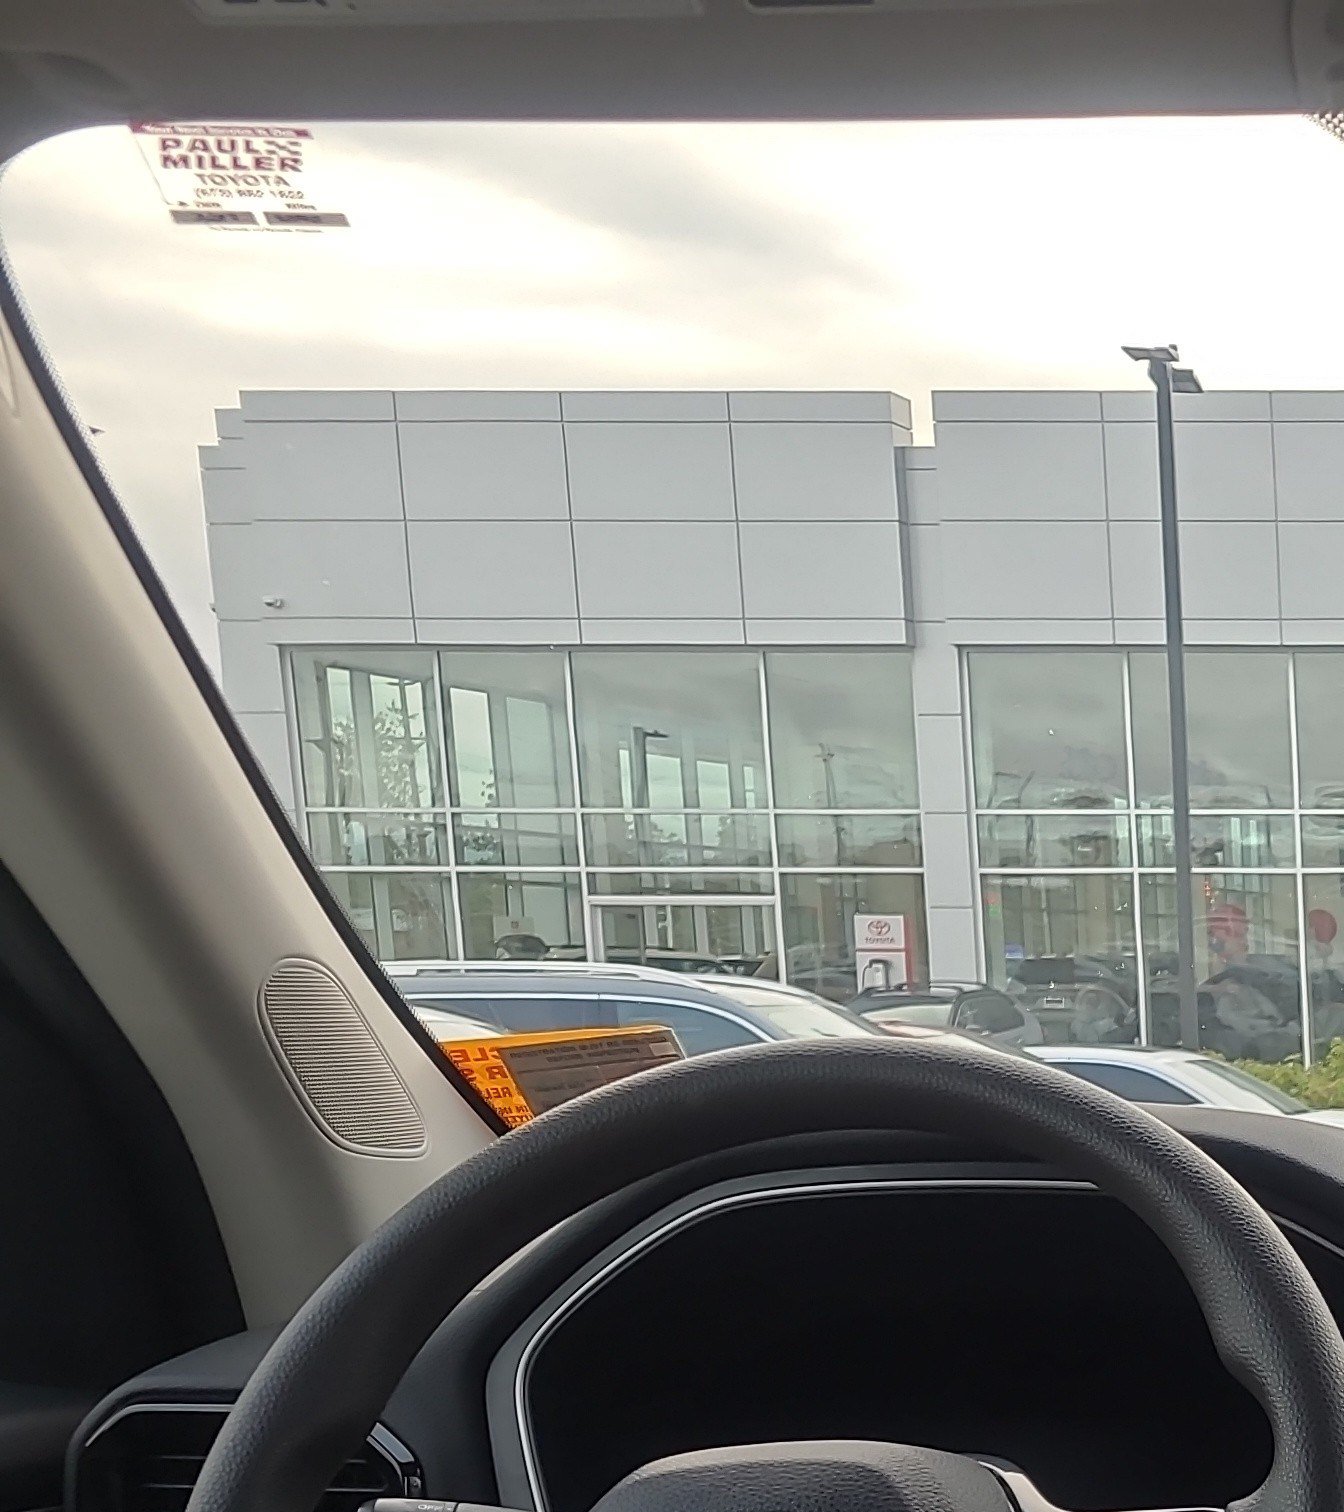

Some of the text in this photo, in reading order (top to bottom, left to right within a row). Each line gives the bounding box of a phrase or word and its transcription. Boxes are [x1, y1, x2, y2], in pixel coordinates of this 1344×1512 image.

[160, 137, 262, 154] PAUL
[161, 154, 303, 172] MILLER
[194, 173, 290, 187] TOYOTA
